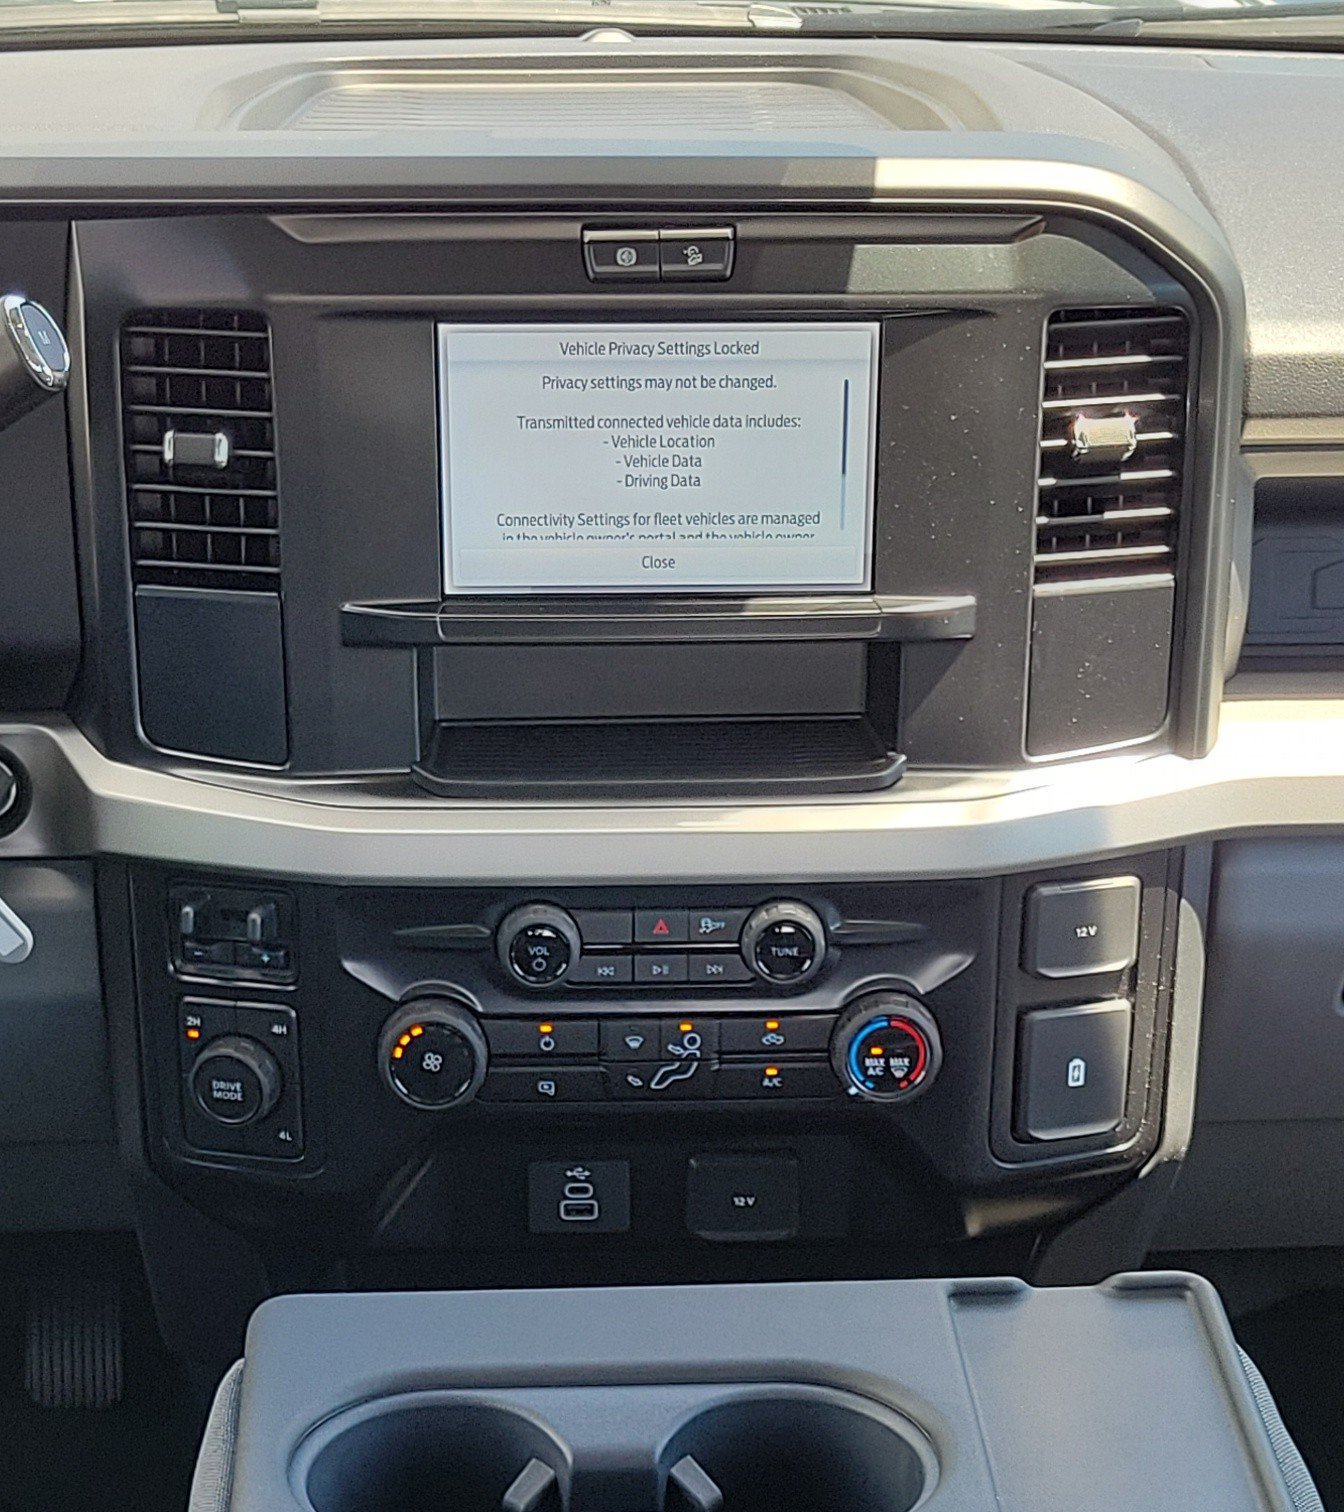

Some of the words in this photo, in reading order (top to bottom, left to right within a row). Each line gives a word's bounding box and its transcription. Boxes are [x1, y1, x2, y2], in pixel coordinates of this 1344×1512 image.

[560, 341, 605, 355] Vehicle
[609, 341, 654, 358] Privacy
[657, 341, 711, 357] Settings
[714, 341, 759, 355] Locked
[542, 375, 587, 391] Privacy
[590, 375, 642, 391] settings
[644, 378, 672, 391] may
[674, 376, 697, 388] not
[700, 374, 716, 388] be
[718, 374, 777, 391] changed.
[517, 414, 595, 429] Transmitted
[597, 414, 663, 429] connected
[666, 414, 710, 428] vehicle
[712, 414, 742, 428] data
[745, 414, 802, 428] includes:
[611, 435, 656, 448] Vehicle
[659, 435, 715, 448] Location
[624, 455, 668, 468] Vehicle
[671, 455, 702, 468] Data
[625, 474, 668, 489] Driving
[671, 474, 701, 488] Data
[497, 513, 574, 528] Connectivity
[577, 512, 630, 528] Settings
[633, 512, 651, 526] for
[654, 512, 682, 525] fleet
[685, 512, 736, 525] vehicles
[738, 514, 759, 525] are
[761, 511, 821, 527] managed
[641, 555, 676, 569] Close
[528, 947, 550, 957] VOL
[771, 946, 799, 957] TUNE
[186, 1016, 201, 1027] 2H
[271, 1025, 288, 1035] 4H
[212, 1080, 243, 1091] DRIVE
[763, 1078, 783, 1087] A/C
[213, 1090, 244, 1101] MODE
[278, 1131, 293, 1141] 4L
